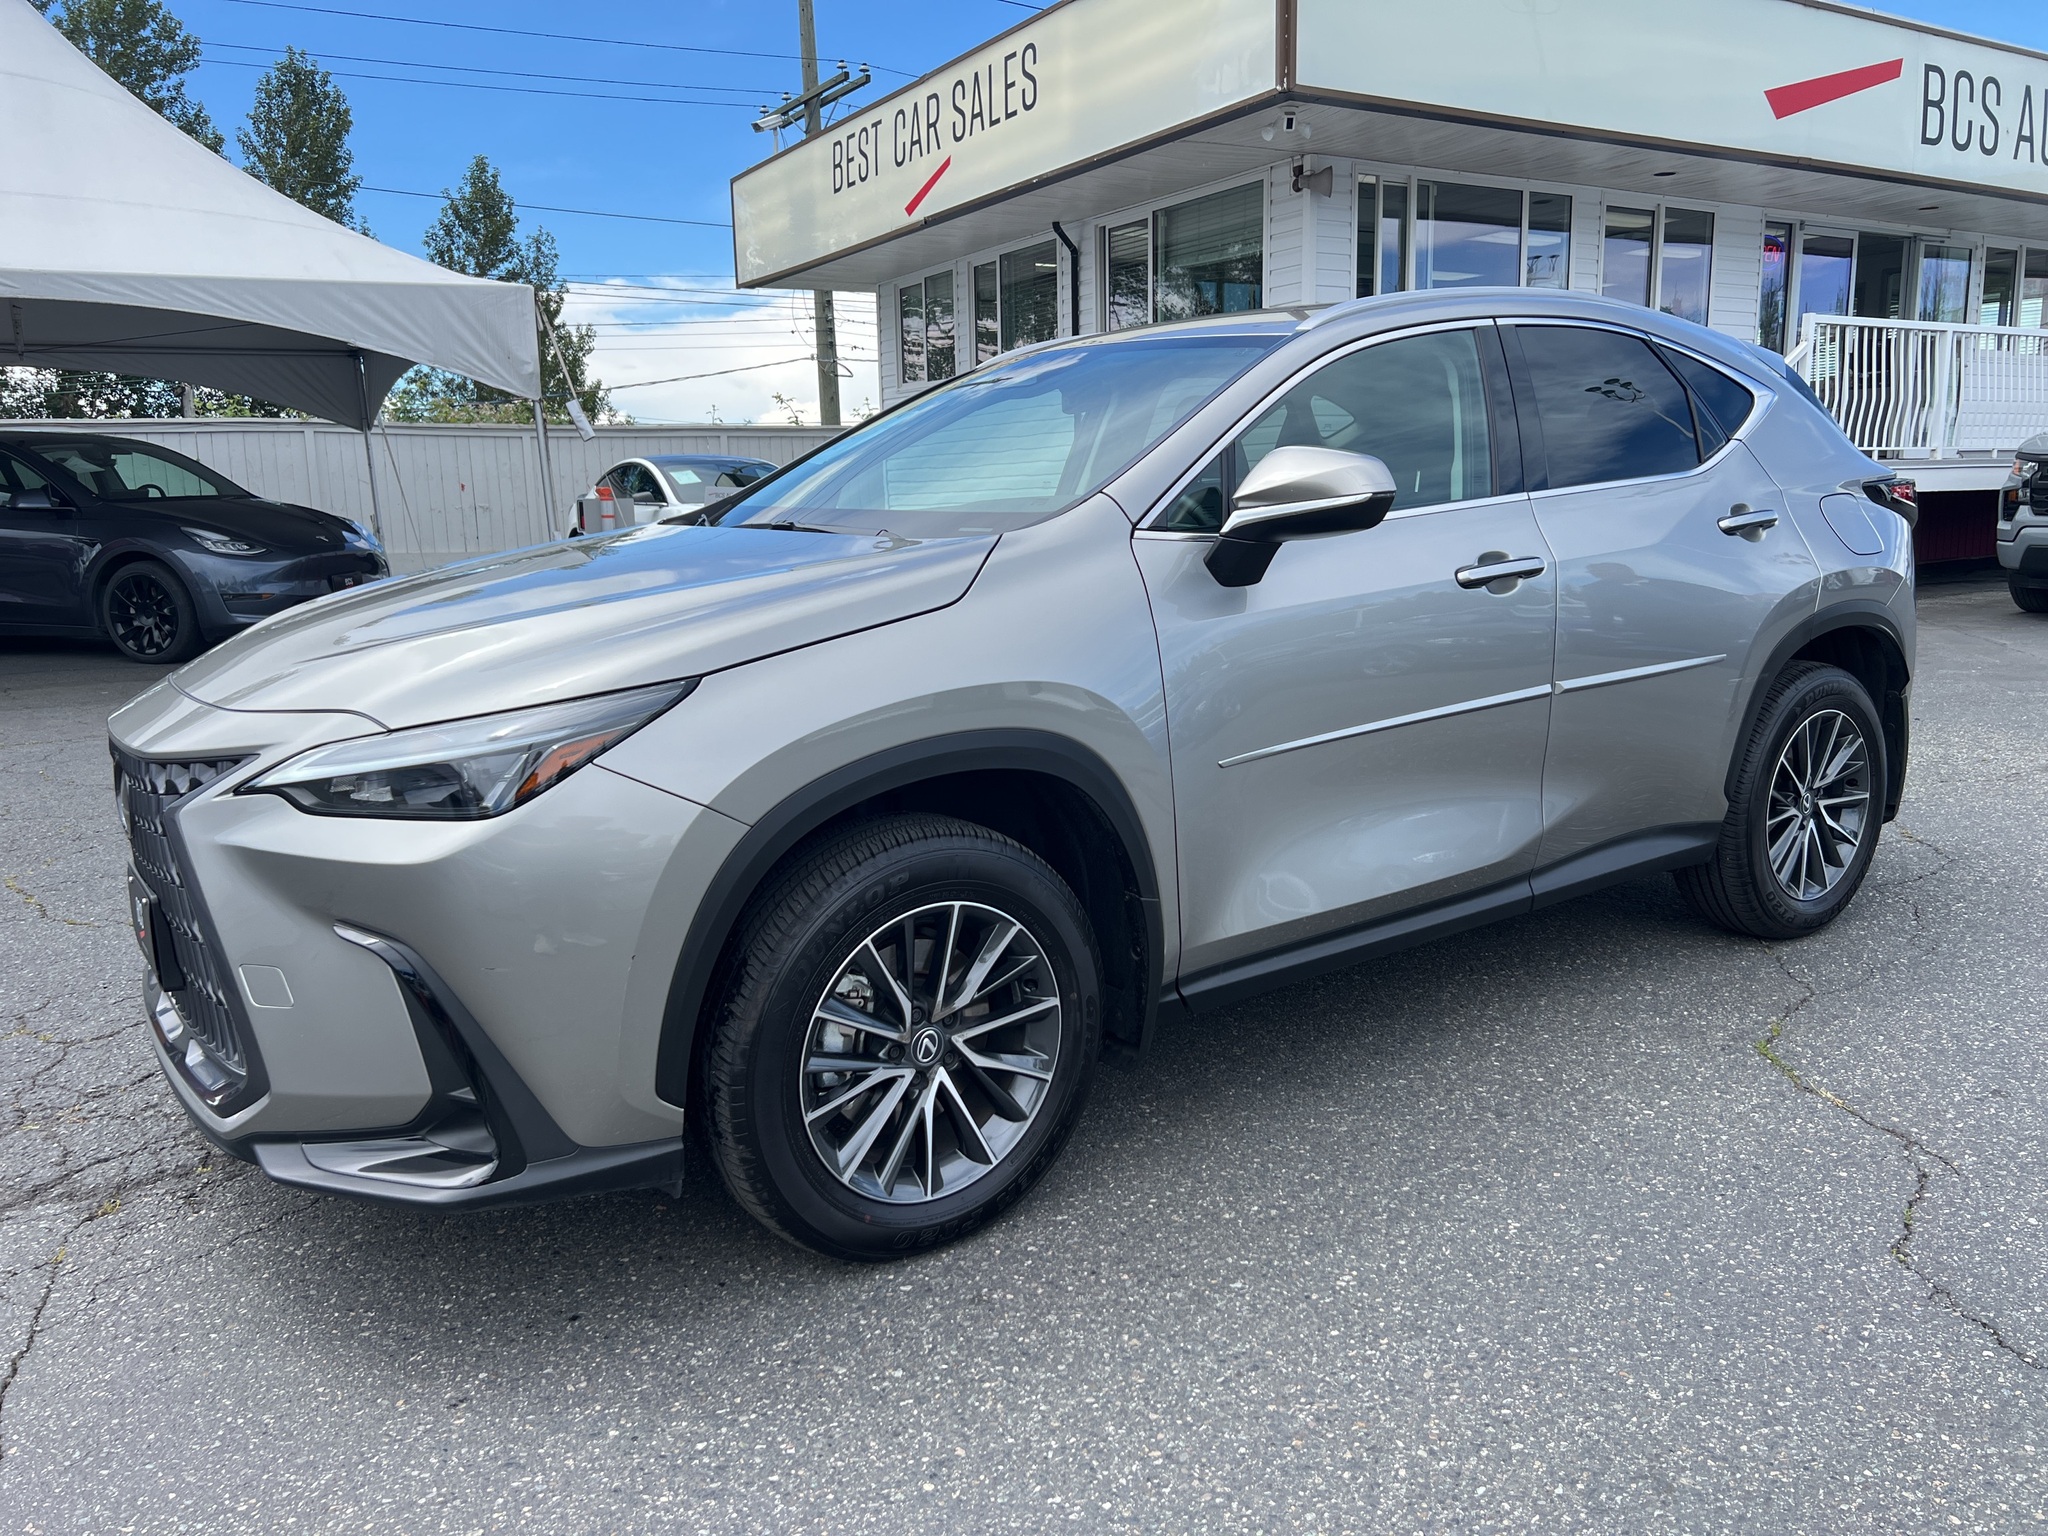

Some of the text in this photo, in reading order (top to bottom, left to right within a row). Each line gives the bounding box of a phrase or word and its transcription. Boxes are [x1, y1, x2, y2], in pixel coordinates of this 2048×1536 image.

[833, 42, 1038, 194] BEST CAR SALES
[1921, 63, 2001, 156] BCS
[791, 869, 910, 982] DUNLOP
